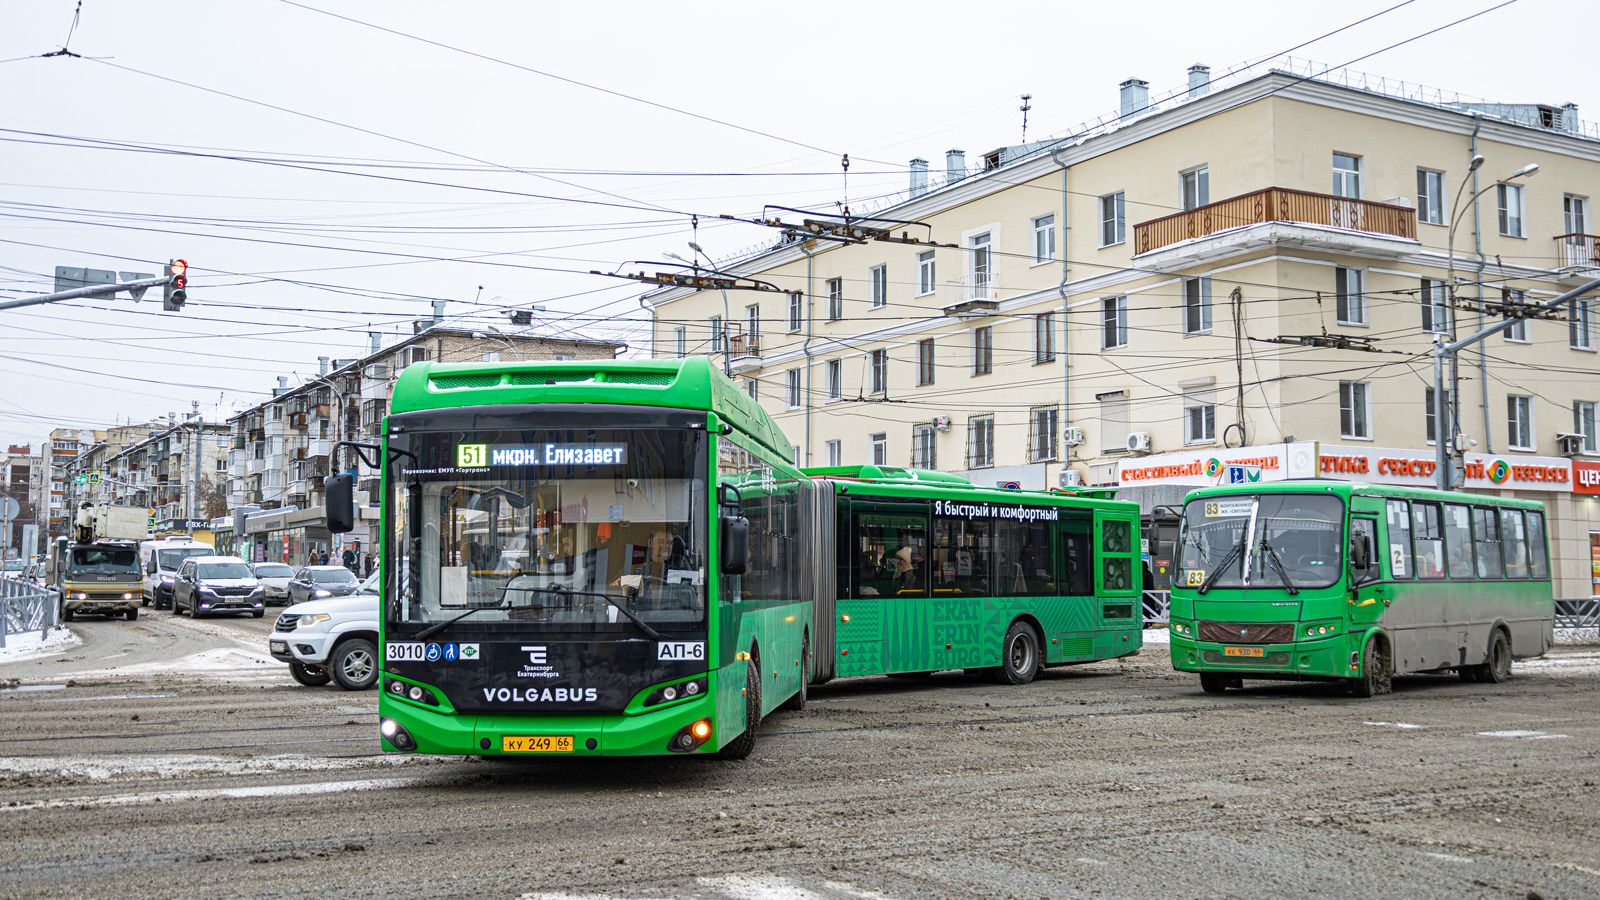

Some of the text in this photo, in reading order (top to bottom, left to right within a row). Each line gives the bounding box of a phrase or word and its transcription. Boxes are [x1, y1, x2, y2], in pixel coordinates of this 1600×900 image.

[177, 279, 184, 288] 5
[463, 443, 623, 466] 51 мкрн. Елизавет
[935, 500, 1058, 523] Я быстрый и комфортный
[1206, 503, 1218, 515] 83
[1189, 572, 1203, 584] 83
[933, 600, 980, 621] EKAT
[933, 624, 980, 646] ERIN
[389, 644, 423, 659] 3010
[660, 644, 703, 658] АП-6
[933, 647, 980, 669] BURG
[1238, 648, 1251, 656] 930
[517, 670, 560, 678] Екатеринбурга
[523, 664, 553, 672] Транспорт
[483, 687, 598, 702] VOLGABUS
[528, 738, 551, 750] 249
[557, 737, 569, 747] 66
